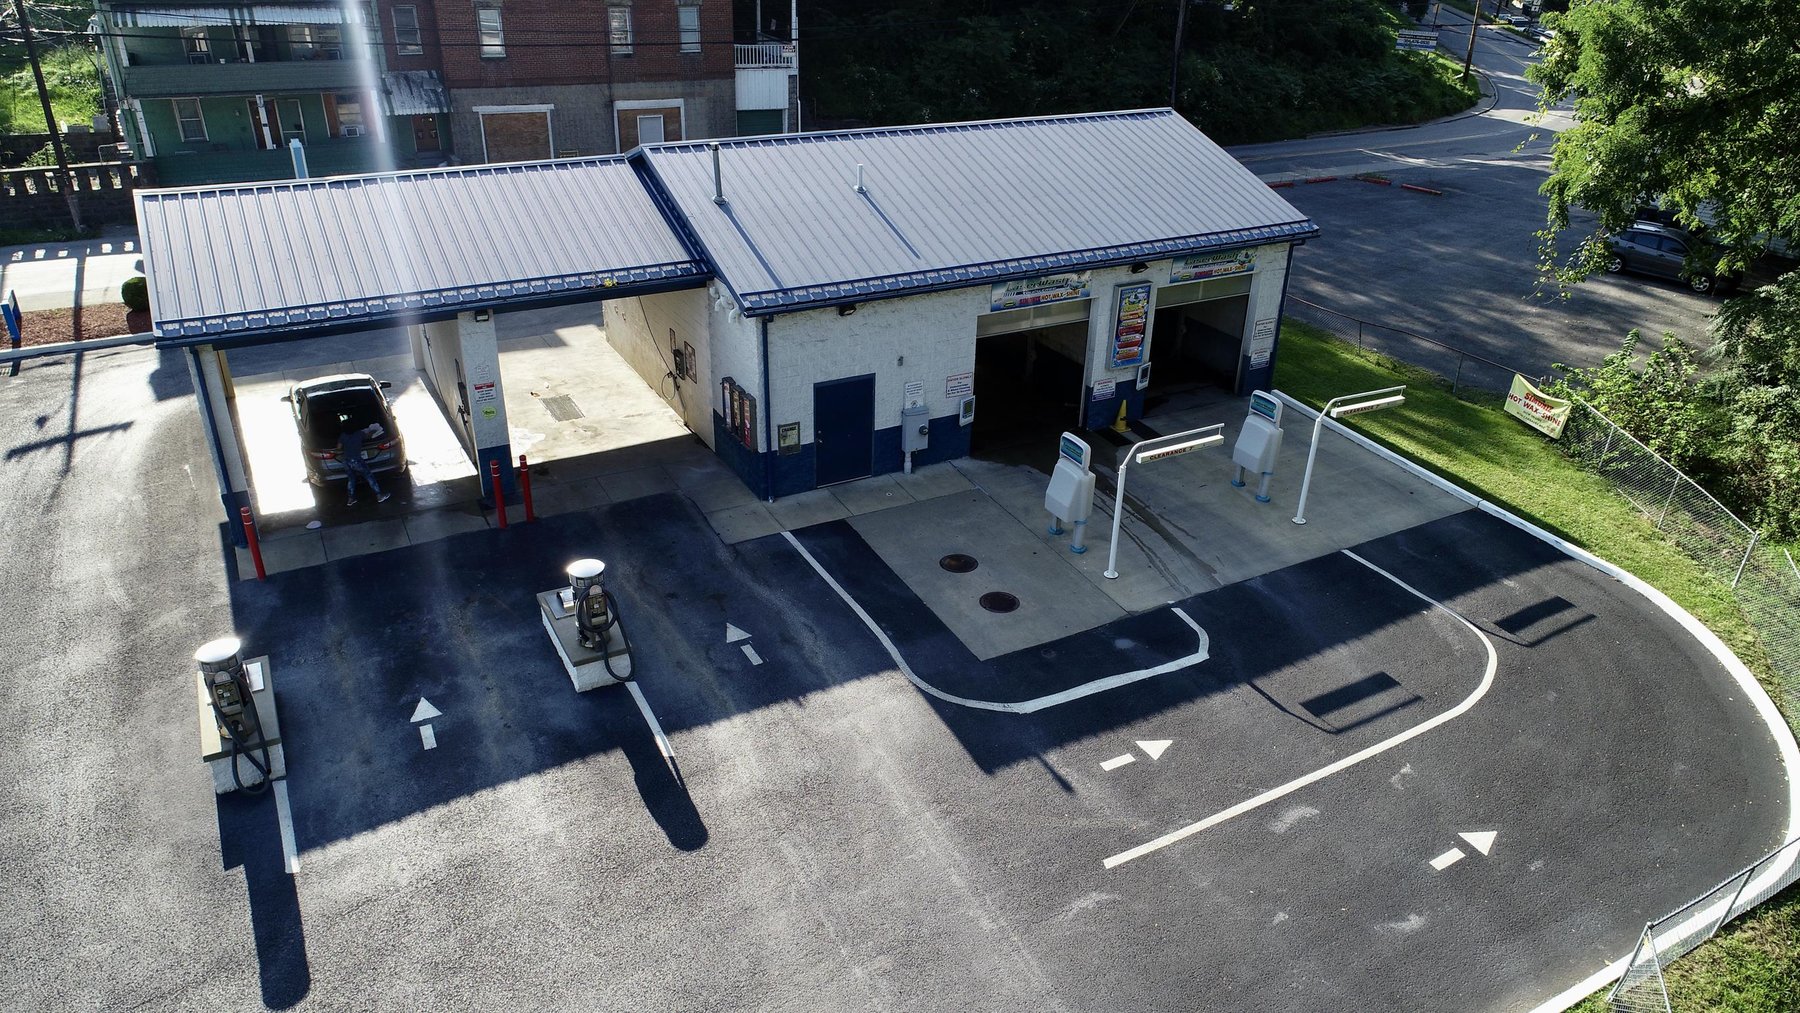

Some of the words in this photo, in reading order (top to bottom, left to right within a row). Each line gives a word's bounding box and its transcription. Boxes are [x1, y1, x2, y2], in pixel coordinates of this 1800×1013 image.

[1508, 392, 1522, 404] HOT
[1343, 406, 1374, 415] CLEARANCE
[1149, 448, 1186, 460] CLEARANCE
